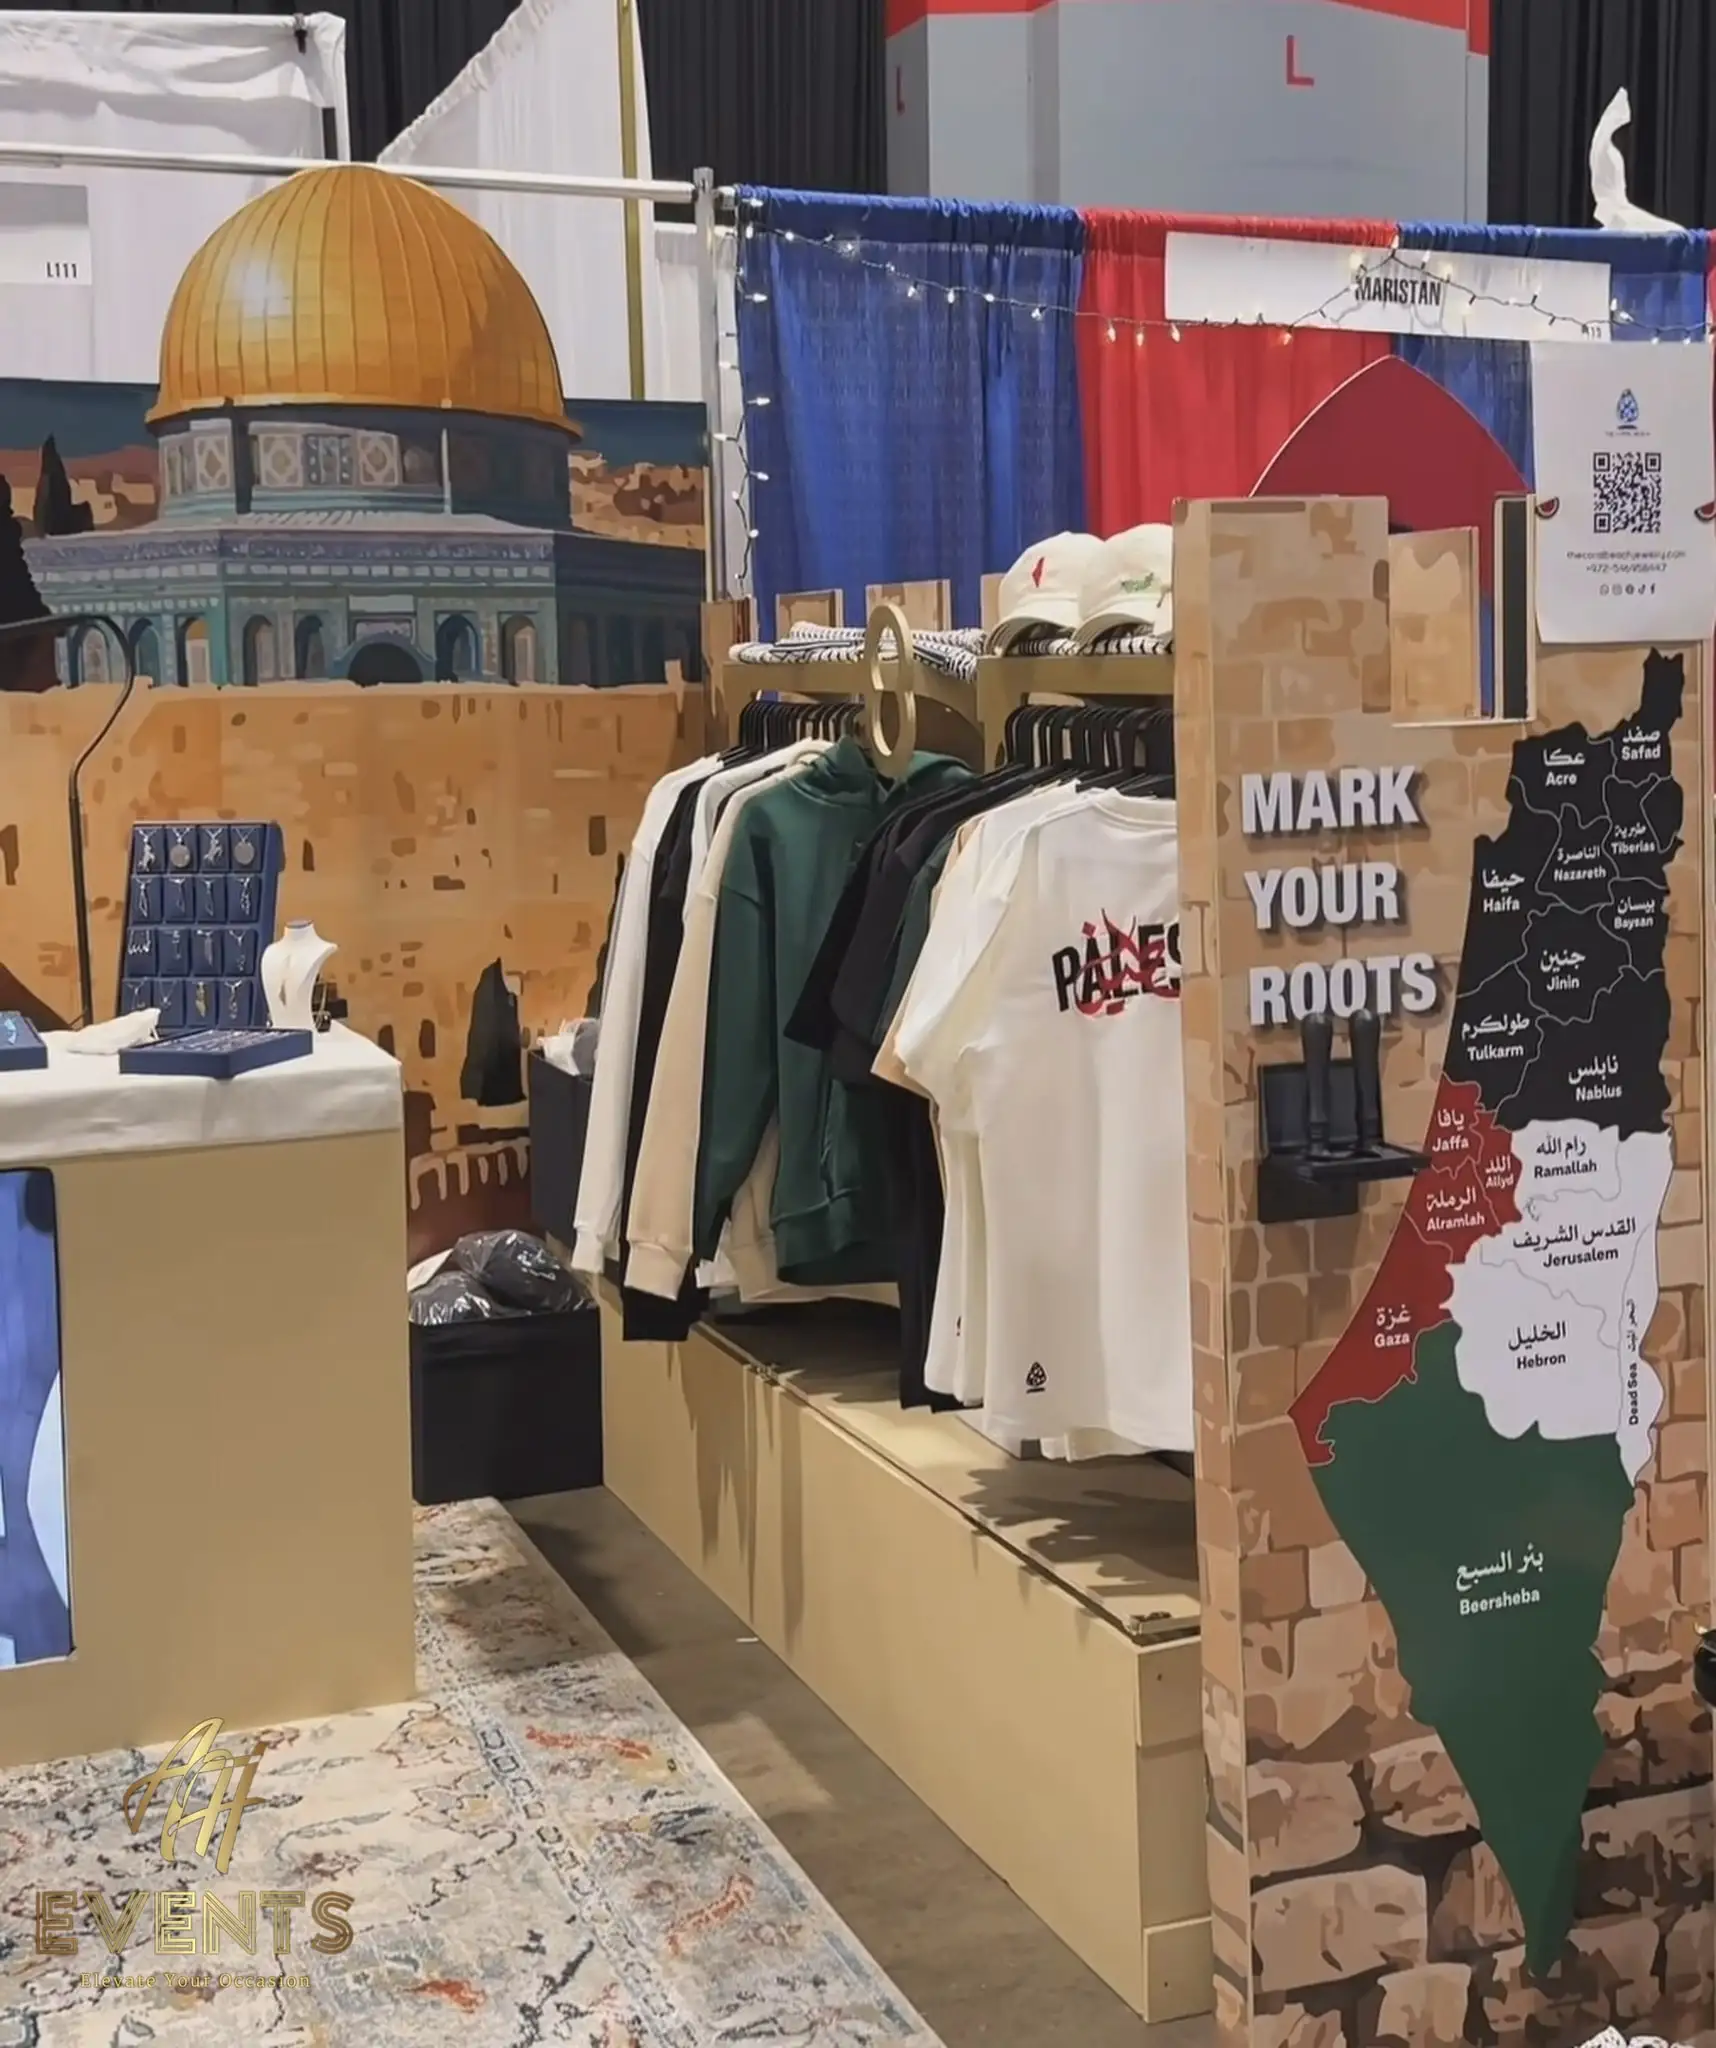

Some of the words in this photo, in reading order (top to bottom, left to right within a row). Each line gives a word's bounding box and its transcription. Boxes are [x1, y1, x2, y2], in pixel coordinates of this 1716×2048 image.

[1285, 35, 1314, 86] L
[896, 66, 906, 113] L
[47, 262, 77, 278] L111
[1355, 276, 1441, 307] MARISTAN
[1543, 748, 1585, 766] عكا
[1621, 744, 1661, 760] Safad
[1545, 772, 1577, 786] Acre
[1241, 765, 1420, 834] MARK
[1558, 845, 1600, 864] الناصرة
[1611, 840, 1655, 855] Tiberias
[1482, 868, 1526, 892] حيفا
[1554, 866, 1606, 881] Nazareth
[1244, 862, 1399, 929] YOUR
[1483, 897, 1520, 912] Haifa
[1617, 893, 1656, 914] بيسان
[1614, 915, 1654, 930] Baysan
[1540, 950, 1585, 972] جنين
[1249, 952, 1436, 1026] ROOTS
[1546, 975, 1580, 991] Jinin
[1462, 1013, 1530, 1040] طولكرم
[1467, 1044, 1524, 1061] Tulkarm
[1568, 1055, 1619, 1085] نابلس
[1576, 1085, 1622, 1102] Nablus
[1438, 1109, 1465, 1130] يافا
[1432, 1135, 1469, 1152] Jaffa
[1534, 1160, 1598, 1180] Ramallah
[1426, 1189, 1476, 1213] الرملة
[1426, 1213, 1486, 1232] Alramlah
[1582, 1218, 1636, 1244] القدس
[1513, 1226, 1579, 1251] الشريف
[1543, 1247, 1619, 1268] Jerusalem
[1376, 1303, 1411, 1329] غزة
[1374, 1330, 1410, 1348] Gaza
[1508, 1322, 1567, 1352] الخليل
[1517, 1352, 1566, 1370] Hebron
[1628, 1363, 1637, 1389] Sea
[1629, 1391, 1638, 1425] Dead
[1516, 1542, 1544, 1574] بئر
[1456, 1549, 1513, 1592] السبع
[1459, 1588, 1541, 1616] Beersheba
